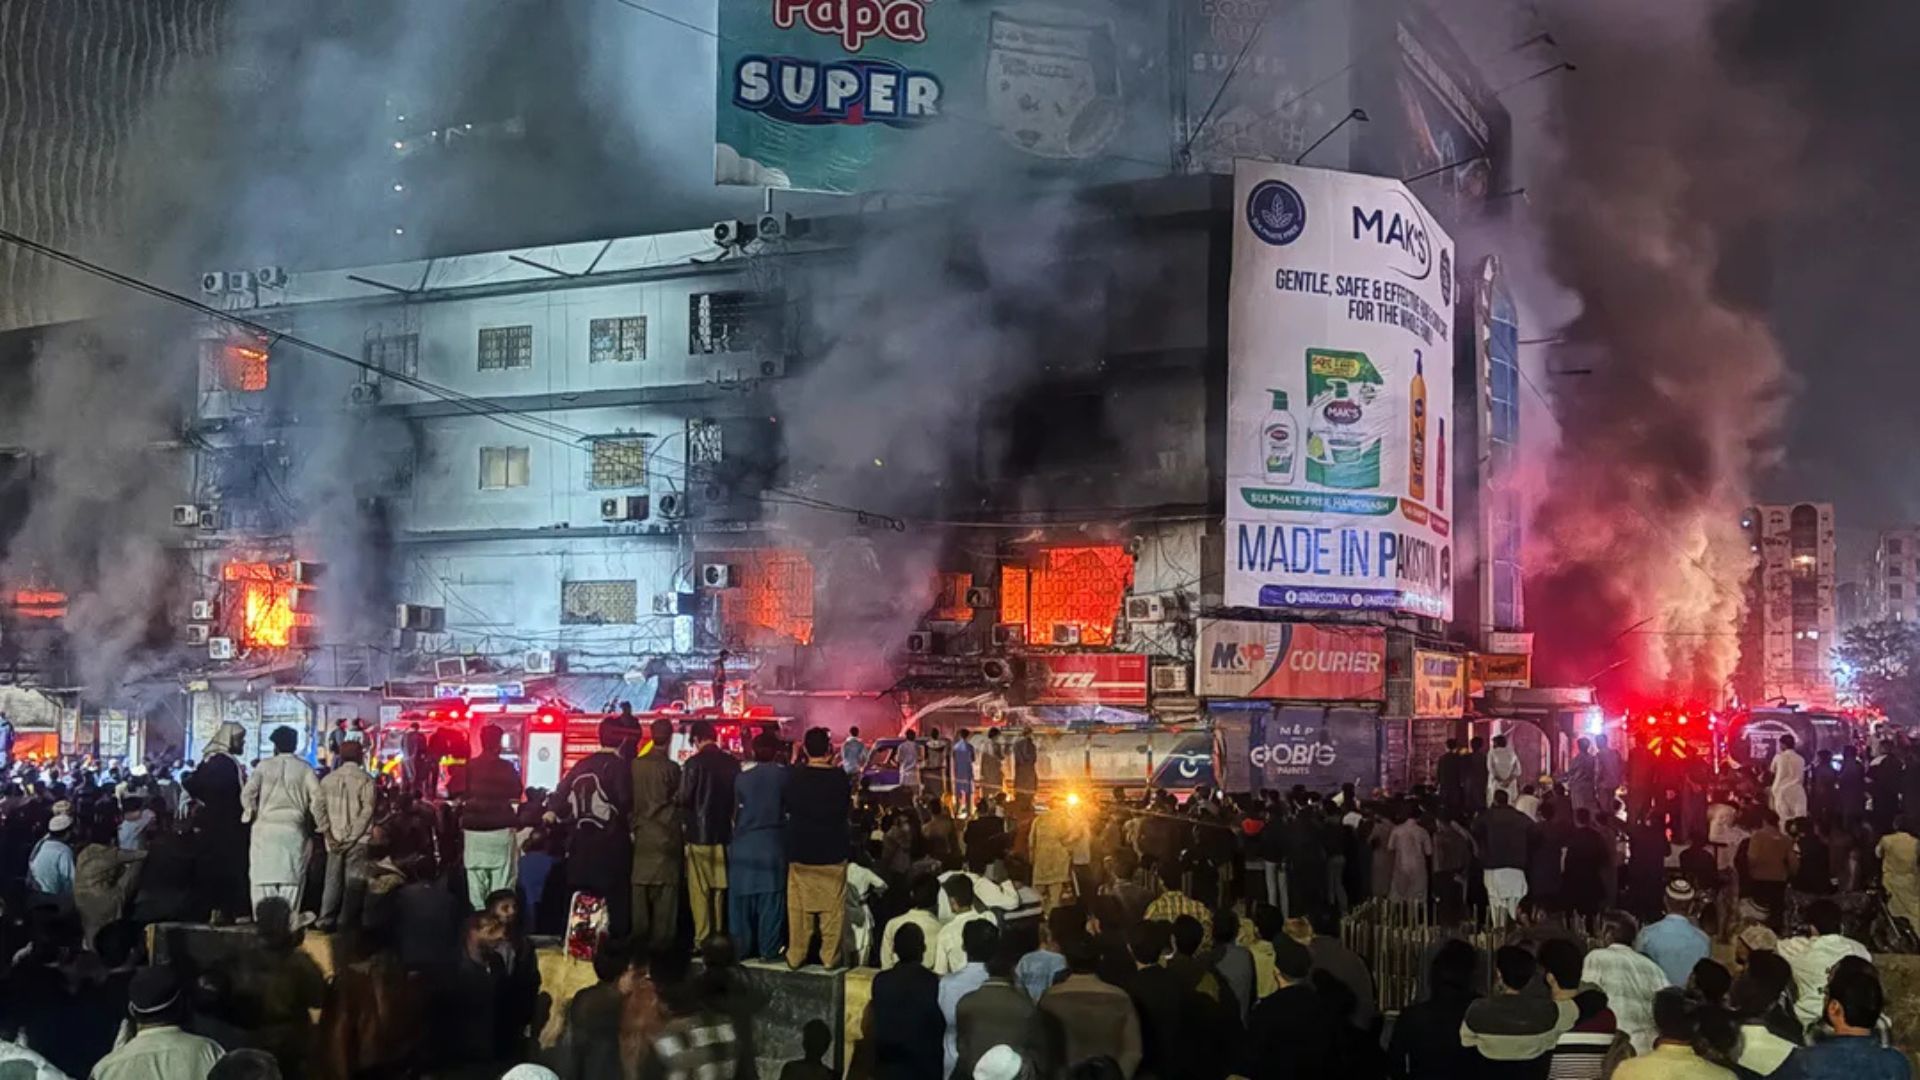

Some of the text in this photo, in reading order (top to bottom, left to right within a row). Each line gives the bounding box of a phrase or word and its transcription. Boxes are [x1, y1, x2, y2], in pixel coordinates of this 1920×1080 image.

[738, 58, 941, 117] SUPER
[1353, 205, 1426, 265] MAK'S
[1276, 268, 1332, 297] GENTLE,
[1336, 275, 1370, 299] SAFE
[1372, 280, 1382, 300] &
[1348, 299, 1374, 322] FOR
[1376, 302, 1399, 326] THE
[1238, 524, 1332, 574] MADE
[1340, 529, 1369, 577] IN
[1211, 642, 1265, 669] M&P
[1289, 650, 1381, 673] COURIER
